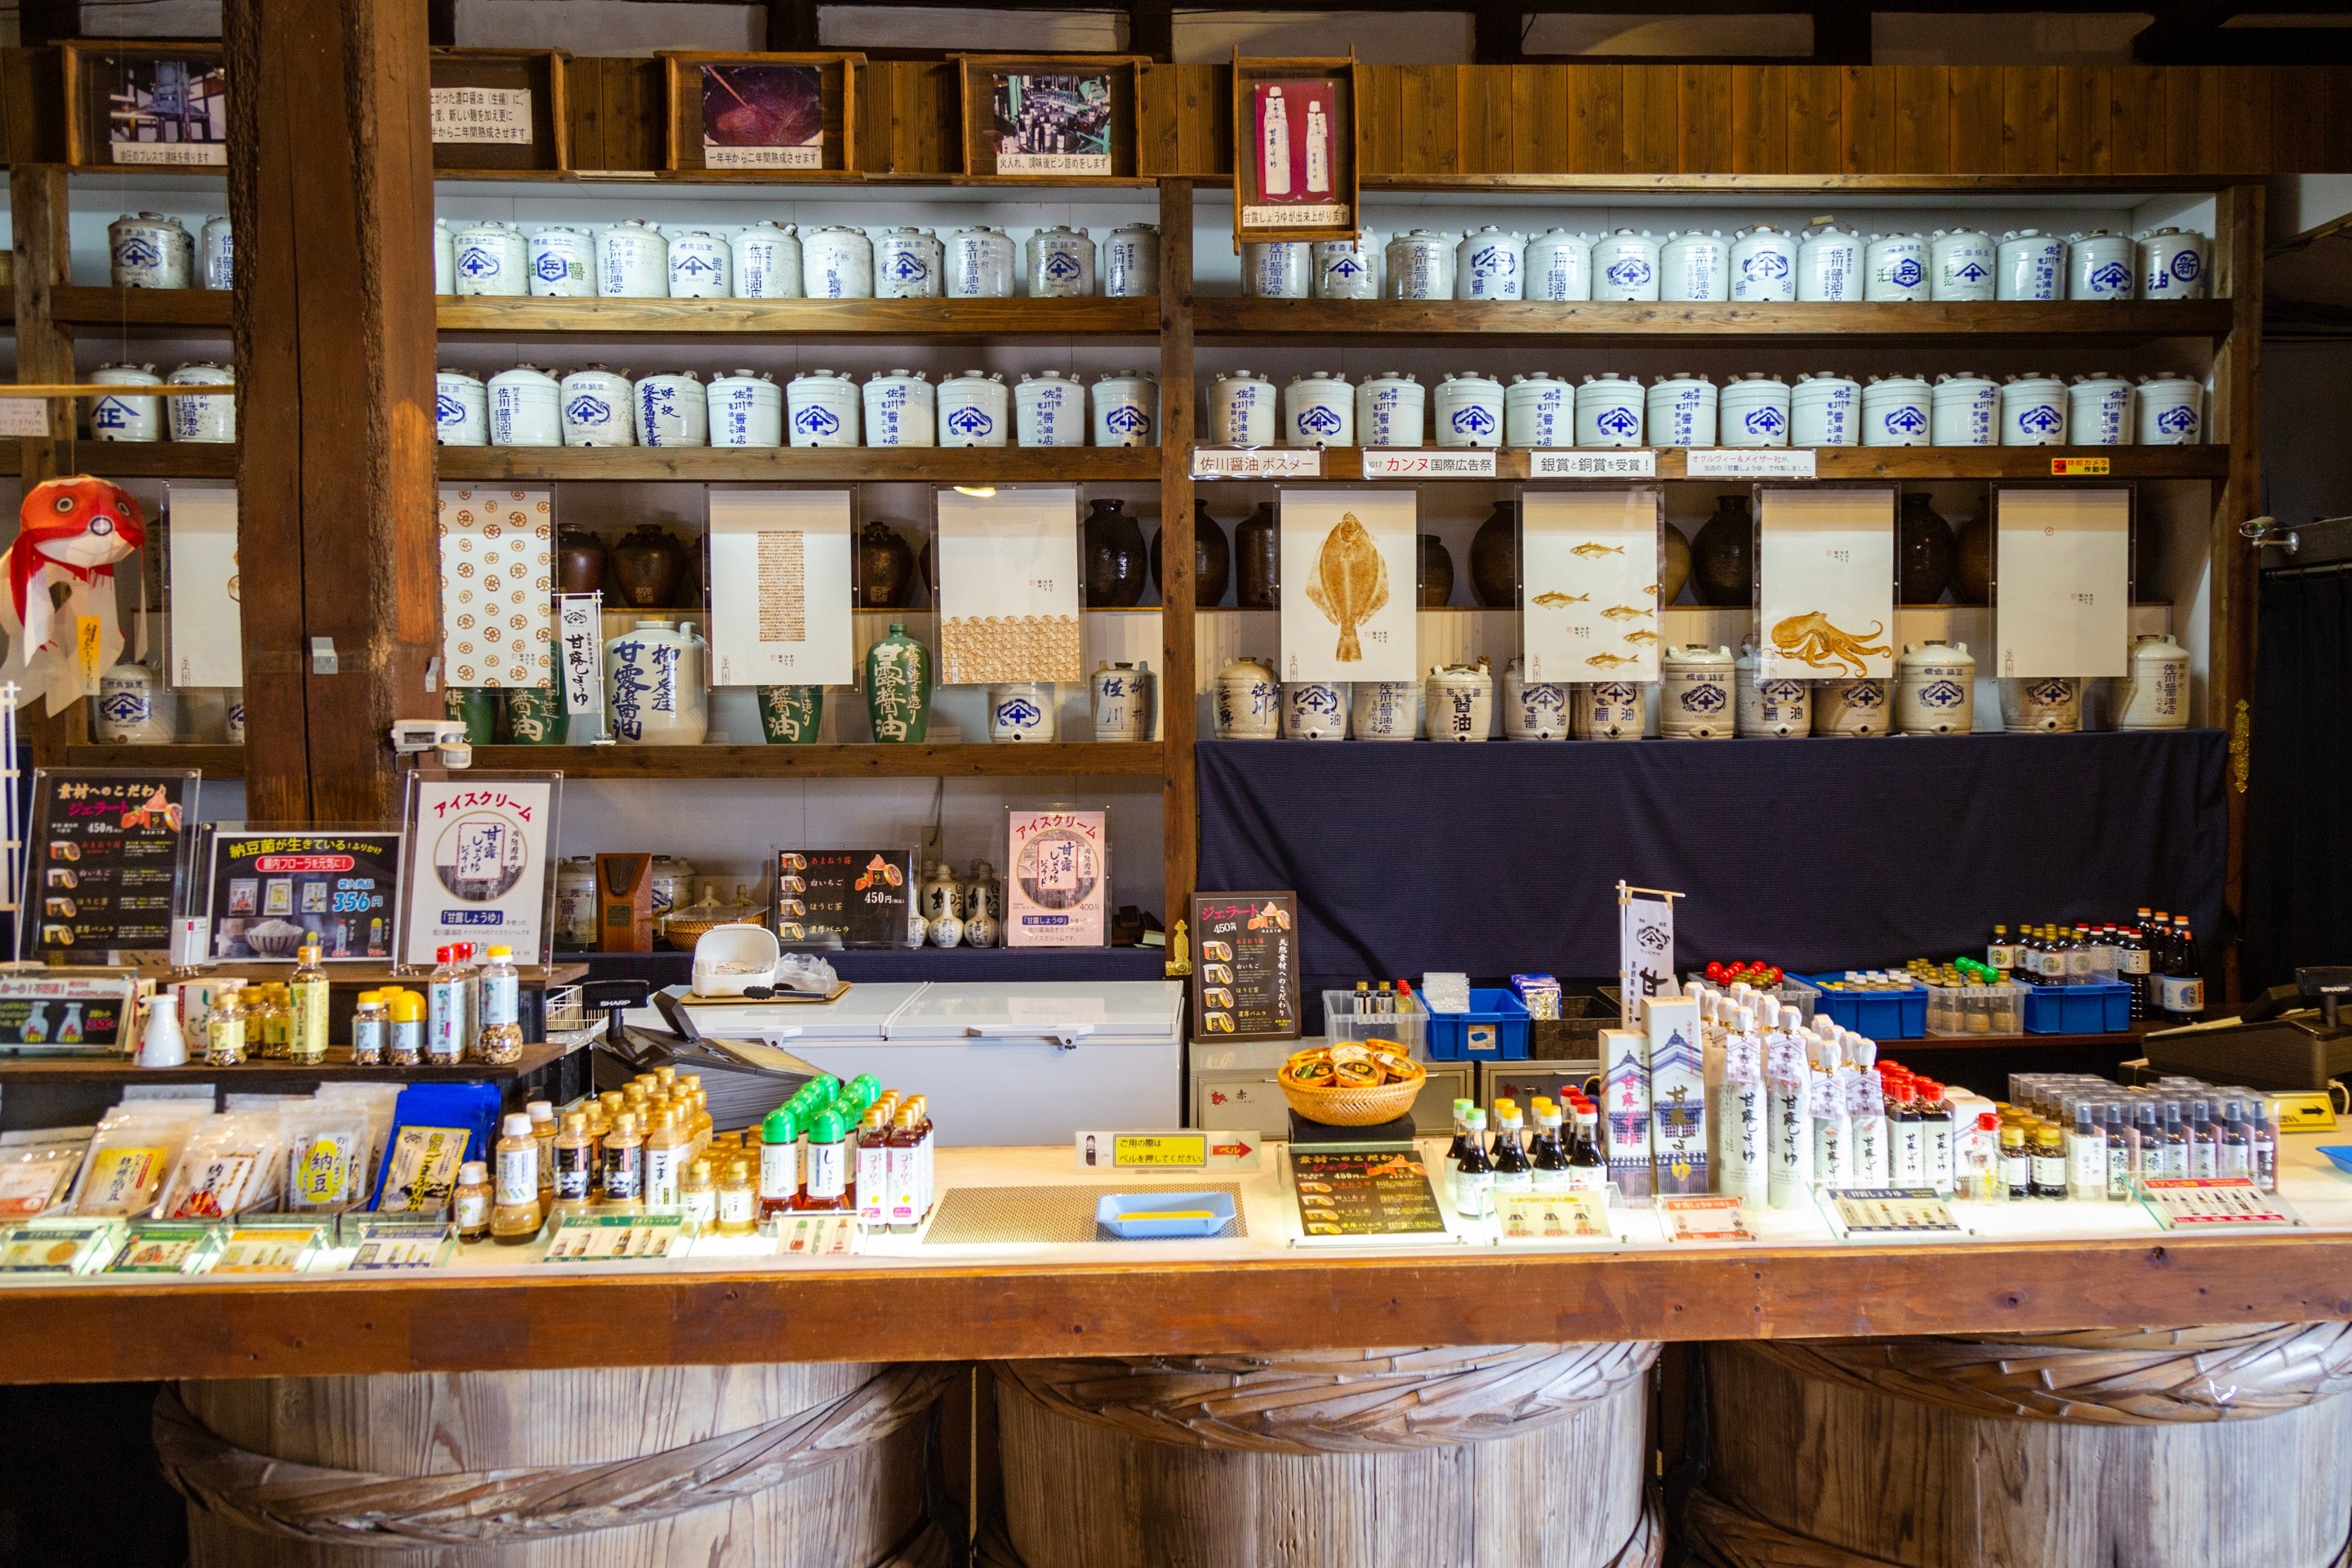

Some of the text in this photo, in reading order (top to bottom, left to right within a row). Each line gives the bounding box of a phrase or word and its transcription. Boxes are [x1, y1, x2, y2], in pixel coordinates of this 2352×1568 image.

[709, 152, 817, 163] 一年半から二年間熟成させます
[1000, 157, 1107, 169] 火入れ、調味後ビン詰めをします
[1244, 211, 1347, 223] 甘露しょうゆが出来上がります
[542, 260, 561, 275] 兵
[1900, 265, 1916, 281] 兵
[2042, 245, 2057, 299] 佐川醤油店
[2178, 256, 2195, 276] 新
[2149, 270, 2170, 292] 油
[97, 408, 126, 429] 正
[497, 388, 512, 443] 佐川醤油店
[733, 390, 746, 444] 佐川醤油店
[885, 389, 899, 444] 佐川醤油店
[1042, 390, 1055, 445] 佐川醤油店
[1236, 389, 1249, 443] 佐川醤油店
[1379, 391, 1391, 445] 佐川醤油店
[1543, 391, 1555, 446] 佐川醤油店
[1681, 390, 1694, 445] 佐川醤油店
[1833, 389, 1845, 444] 佐川醤油店
[1978, 390, 1990, 443] 佐川醤油店
[2108, 390, 2122, 444] 佐川醤油店
[1200, 457, 1314, 471] 佐川醤油 ポスター
[1387, 458, 1491, 471] カンヌ国際広告祭
[1541, 457, 1649, 472] 銀賞と銅賞を受賞！
[565, 634, 590, 706] 甘露しょうゆ
[905, 643, 922, 725] 本醸造手造り
[612, 640, 652, 741] 甘露醤油
[873, 643, 907, 742] 甘露醤油
[1128, 679, 1144, 724] 柳井
[2163, 663, 2177, 715] 佐川醤油店
[1378, 683, 1393, 734] 佐川醤油店
[1454, 694, 1472, 731] 醤油
[57, 782, 167, 800] 素材へのこだわり
[69, 800, 130, 816] ジェラート
[433, 791, 533, 822] アイスクリーム
[1016, 814, 1098, 840] アイスクリーム
[470, 835, 483, 875] しょうゆ
[481, 825, 502, 860] 甘露
[1058, 841, 1076, 871] 甘露
[811, 856, 852, 865] あまおう苺
[338, 880, 375, 889] 袋入商品
[332, 892, 383, 912] 356円
[809, 902, 843, 911] ほうじ茶
[1201, 904, 1258, 921] ジェラート
[442, 912, 502, 924] 「甘露しょうゆ」
[808, 924, 850, 934] 濃厚バニラ
[1022, 916, 1068, 925] 「甘露しょうゆ」
[1277, 938, 1288, 1017] 天然素材へのこだわり
[1236, 1089, 1247, 1100] 赤
[1120, 1139, 1161, 1148] ご用の際は
[1219, 1147, 1241, 1155] ベル
[1120, 1154, 1204, 1163] ベルを押してください。
[312, 1153, 332, 1193] 納豆
